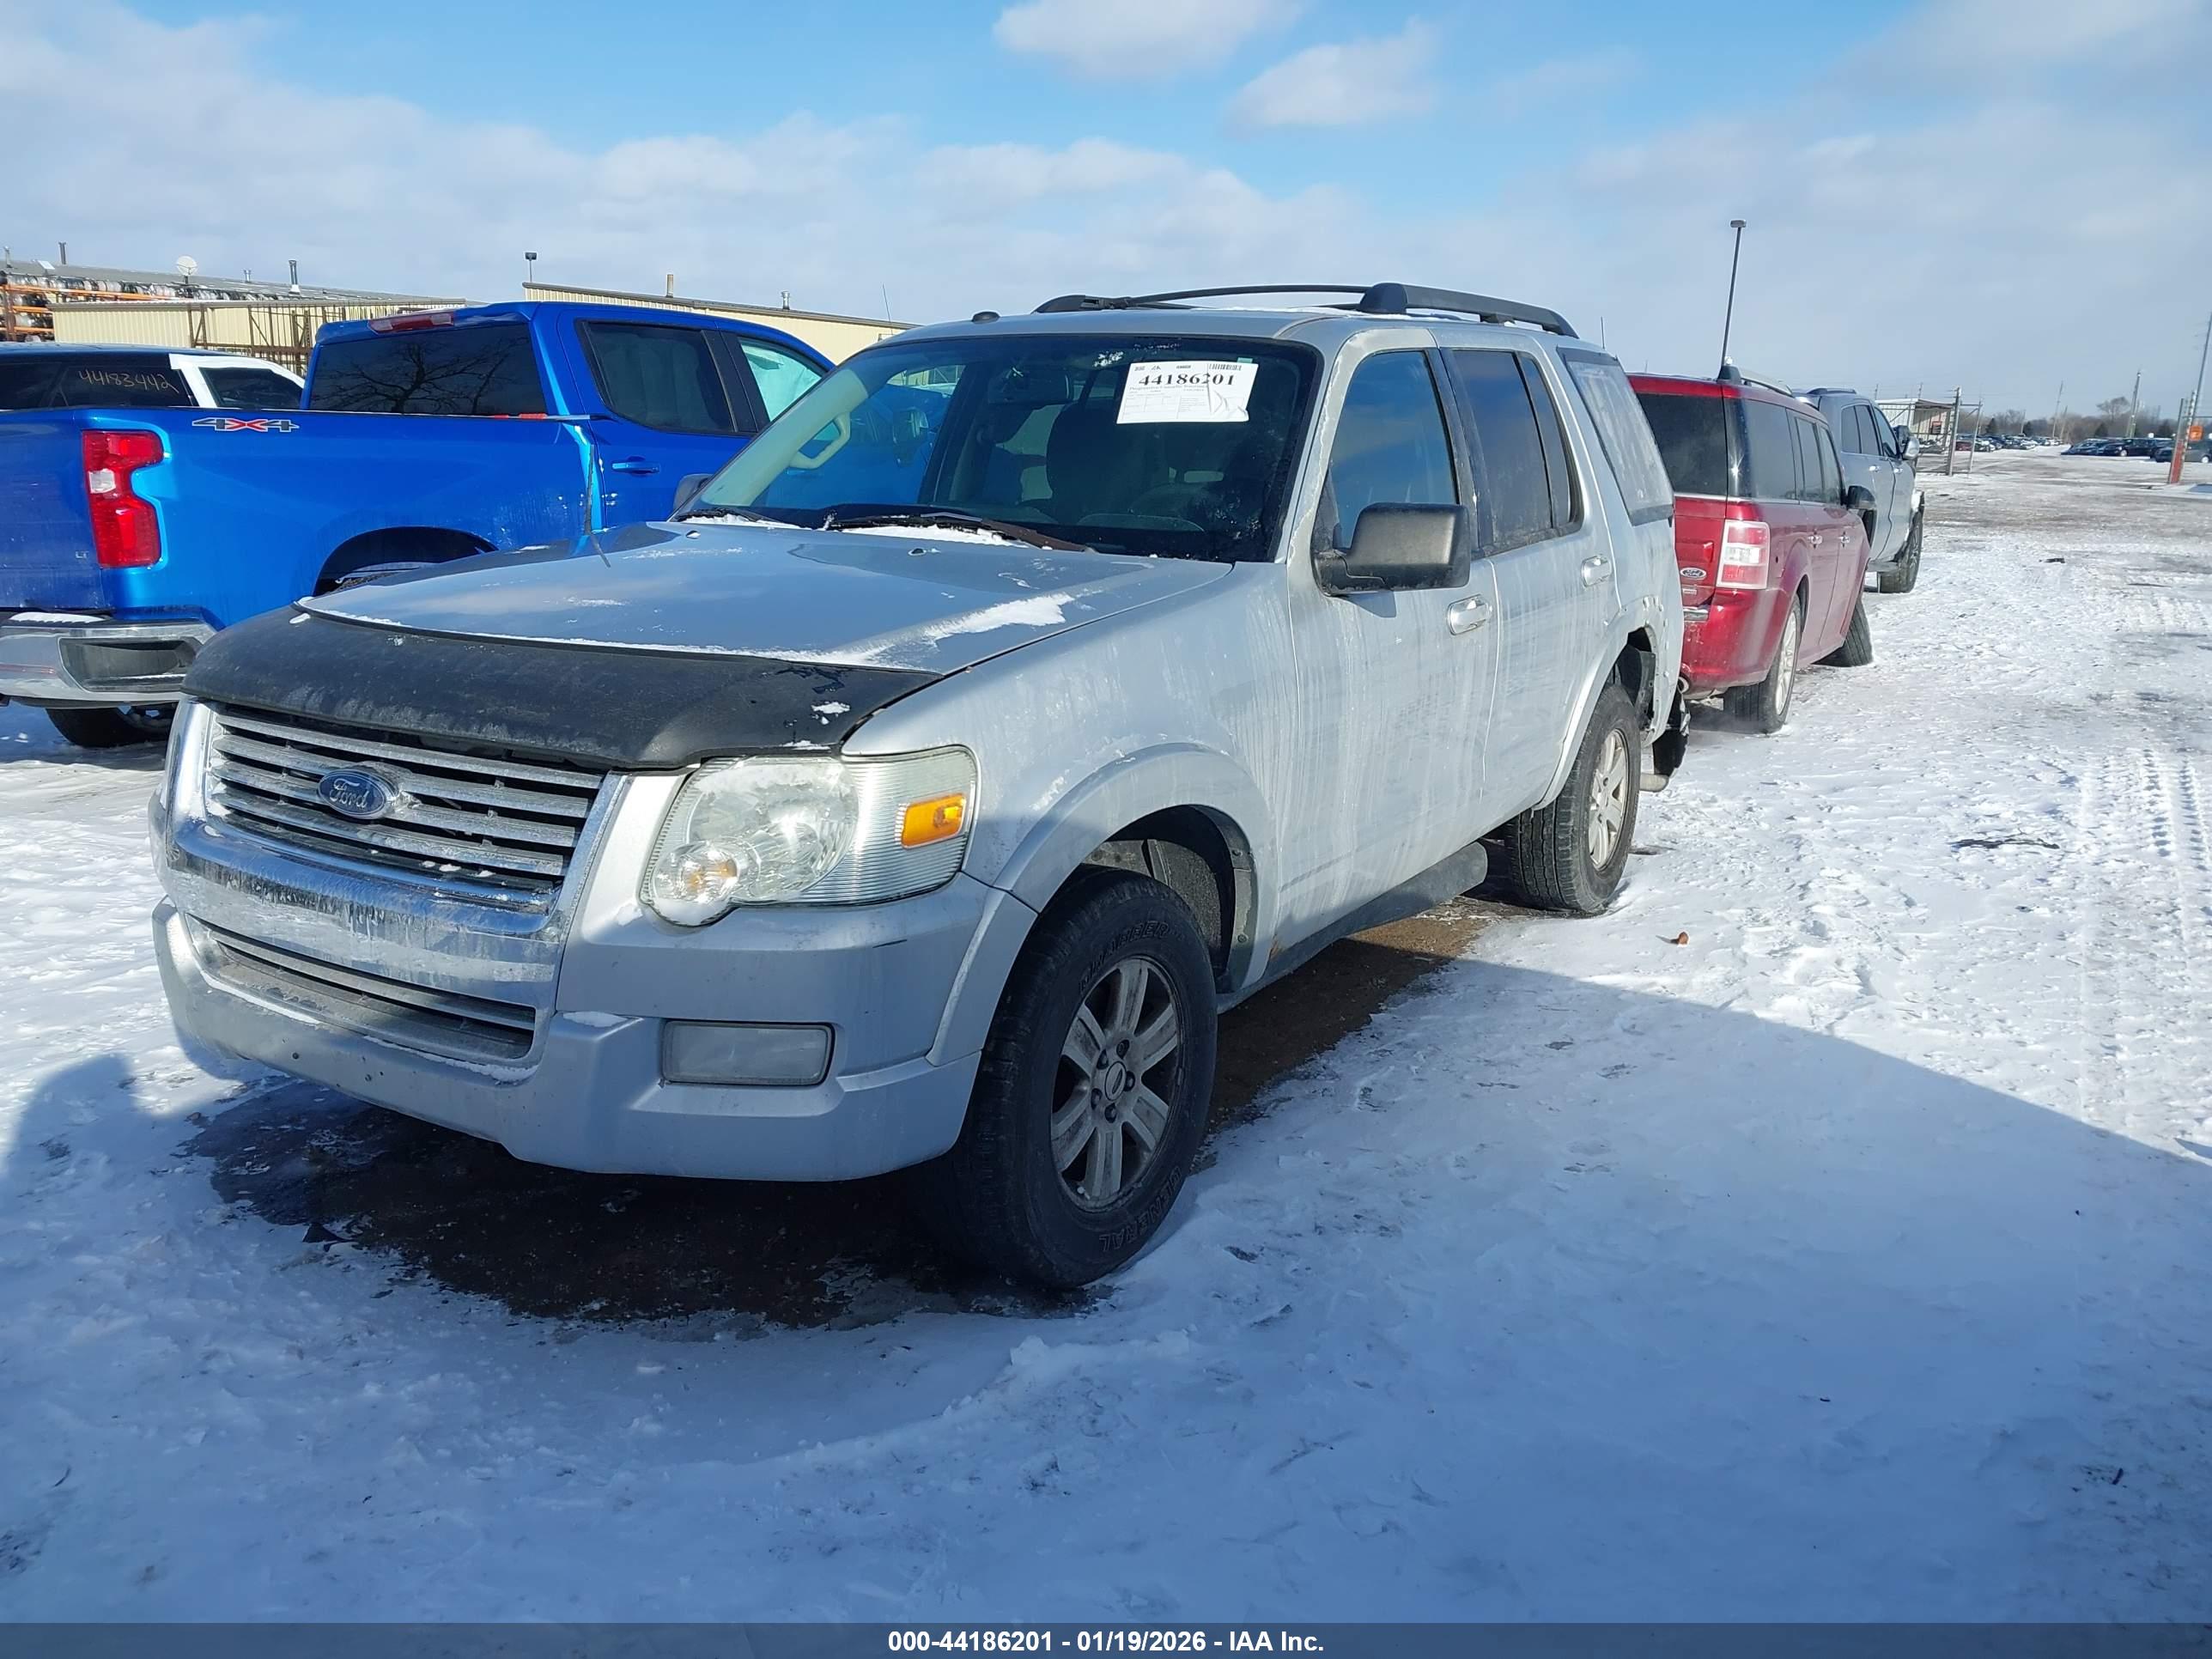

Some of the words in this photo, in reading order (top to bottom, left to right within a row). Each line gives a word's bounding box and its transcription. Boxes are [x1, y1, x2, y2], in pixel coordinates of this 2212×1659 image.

[78, 369, 179, 393] 44183442
[1139, 373, 1234, 386] 44186201
[329, 778, 370, 808] Ford
